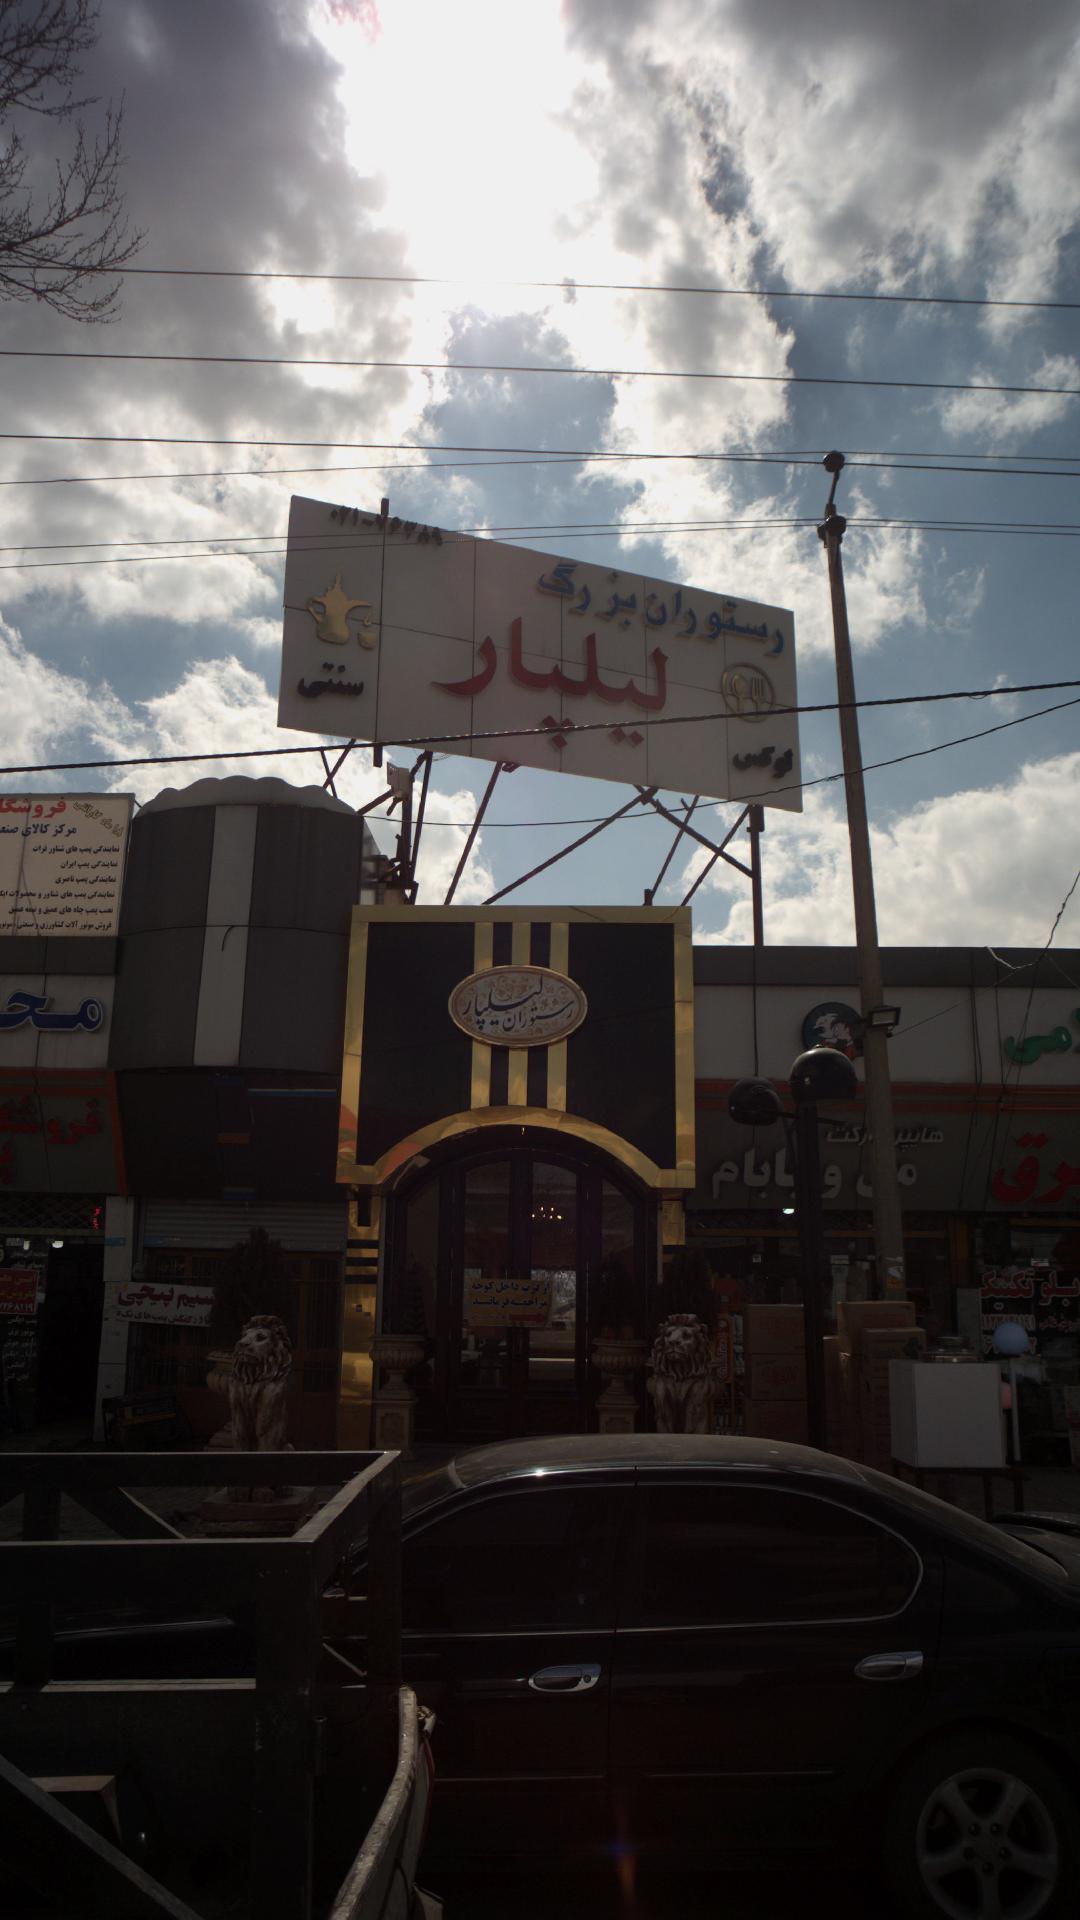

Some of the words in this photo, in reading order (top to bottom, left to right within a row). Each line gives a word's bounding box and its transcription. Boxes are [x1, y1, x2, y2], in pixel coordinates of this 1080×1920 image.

[537, 563, 637, 629] بزرگ
[645, 589, 785, 656] رستوران
[297, 661, 364, 698] سنتی
[21, 823, 49, 837] کالای
[52, 824, 77, 837] مرکز
[502, 1000, 574, 1031] رستوران
[820, 1164, 842, 1199] و
